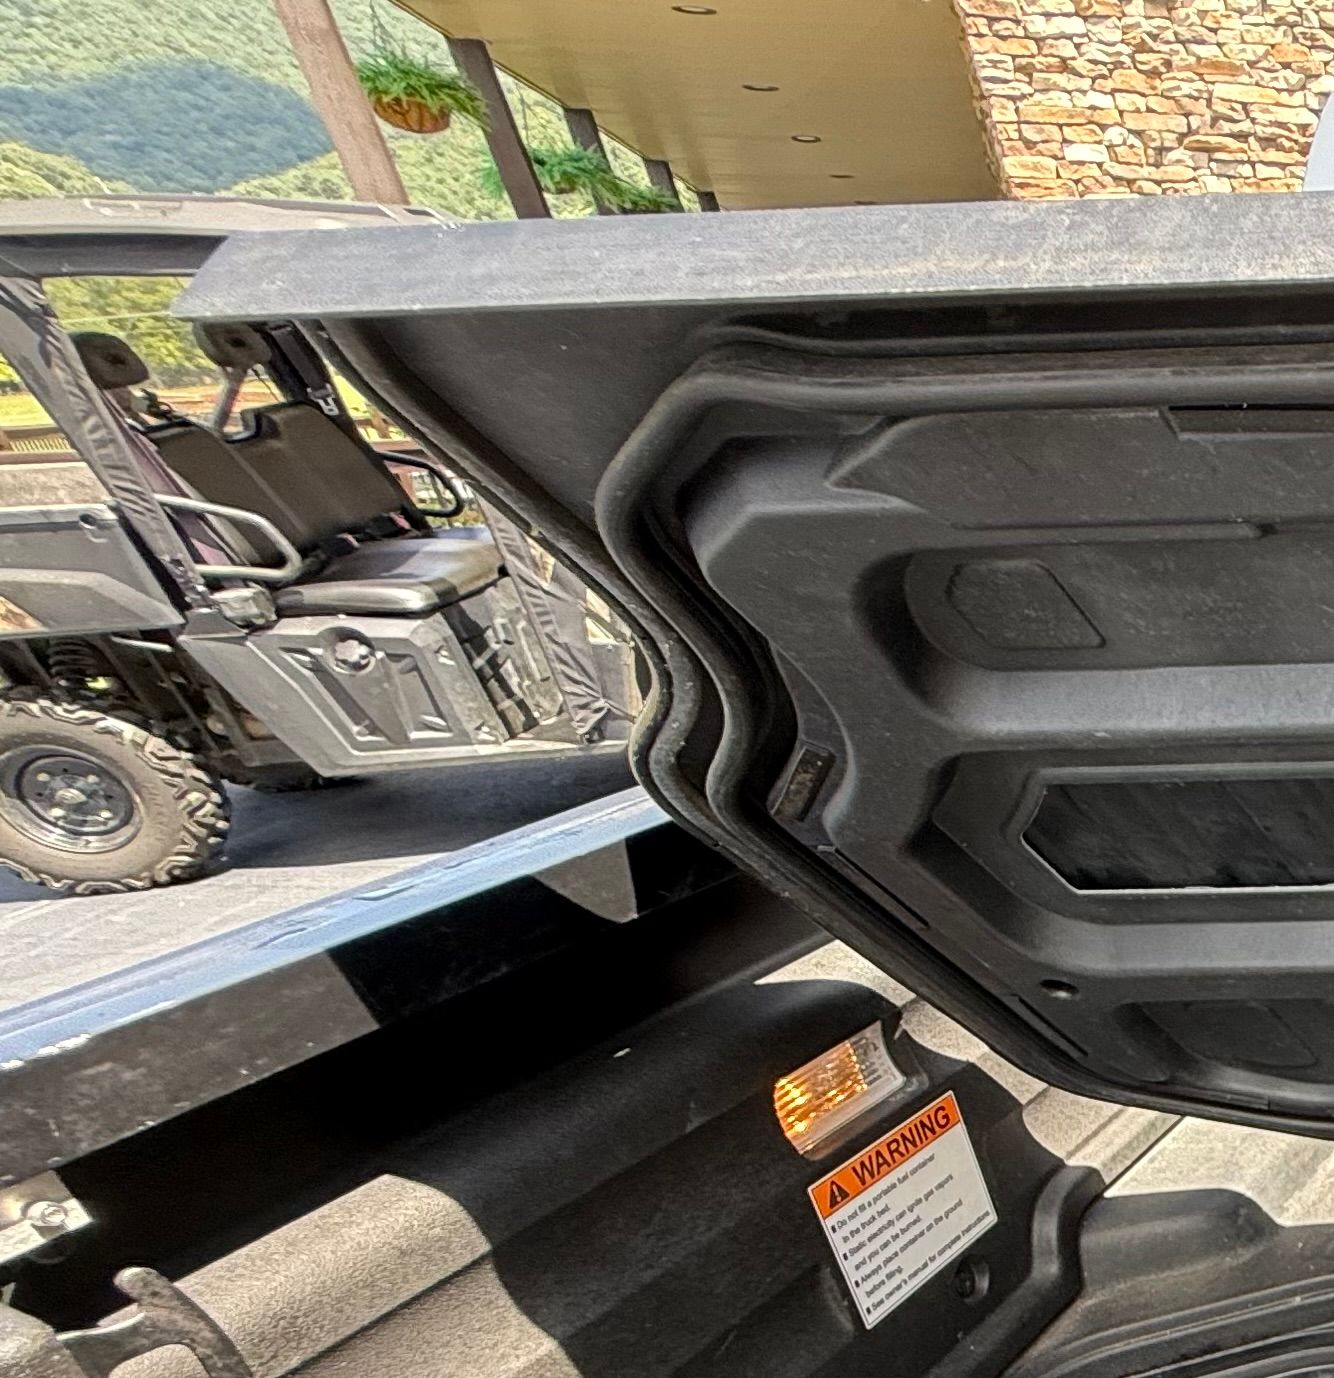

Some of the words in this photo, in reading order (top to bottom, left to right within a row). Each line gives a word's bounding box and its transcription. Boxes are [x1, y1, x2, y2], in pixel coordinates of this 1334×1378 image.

[852, 1106, 950, 1185] WARNING
[836, 1218, 848, 1230] Do
[867, 1200, 873, 1208] a
